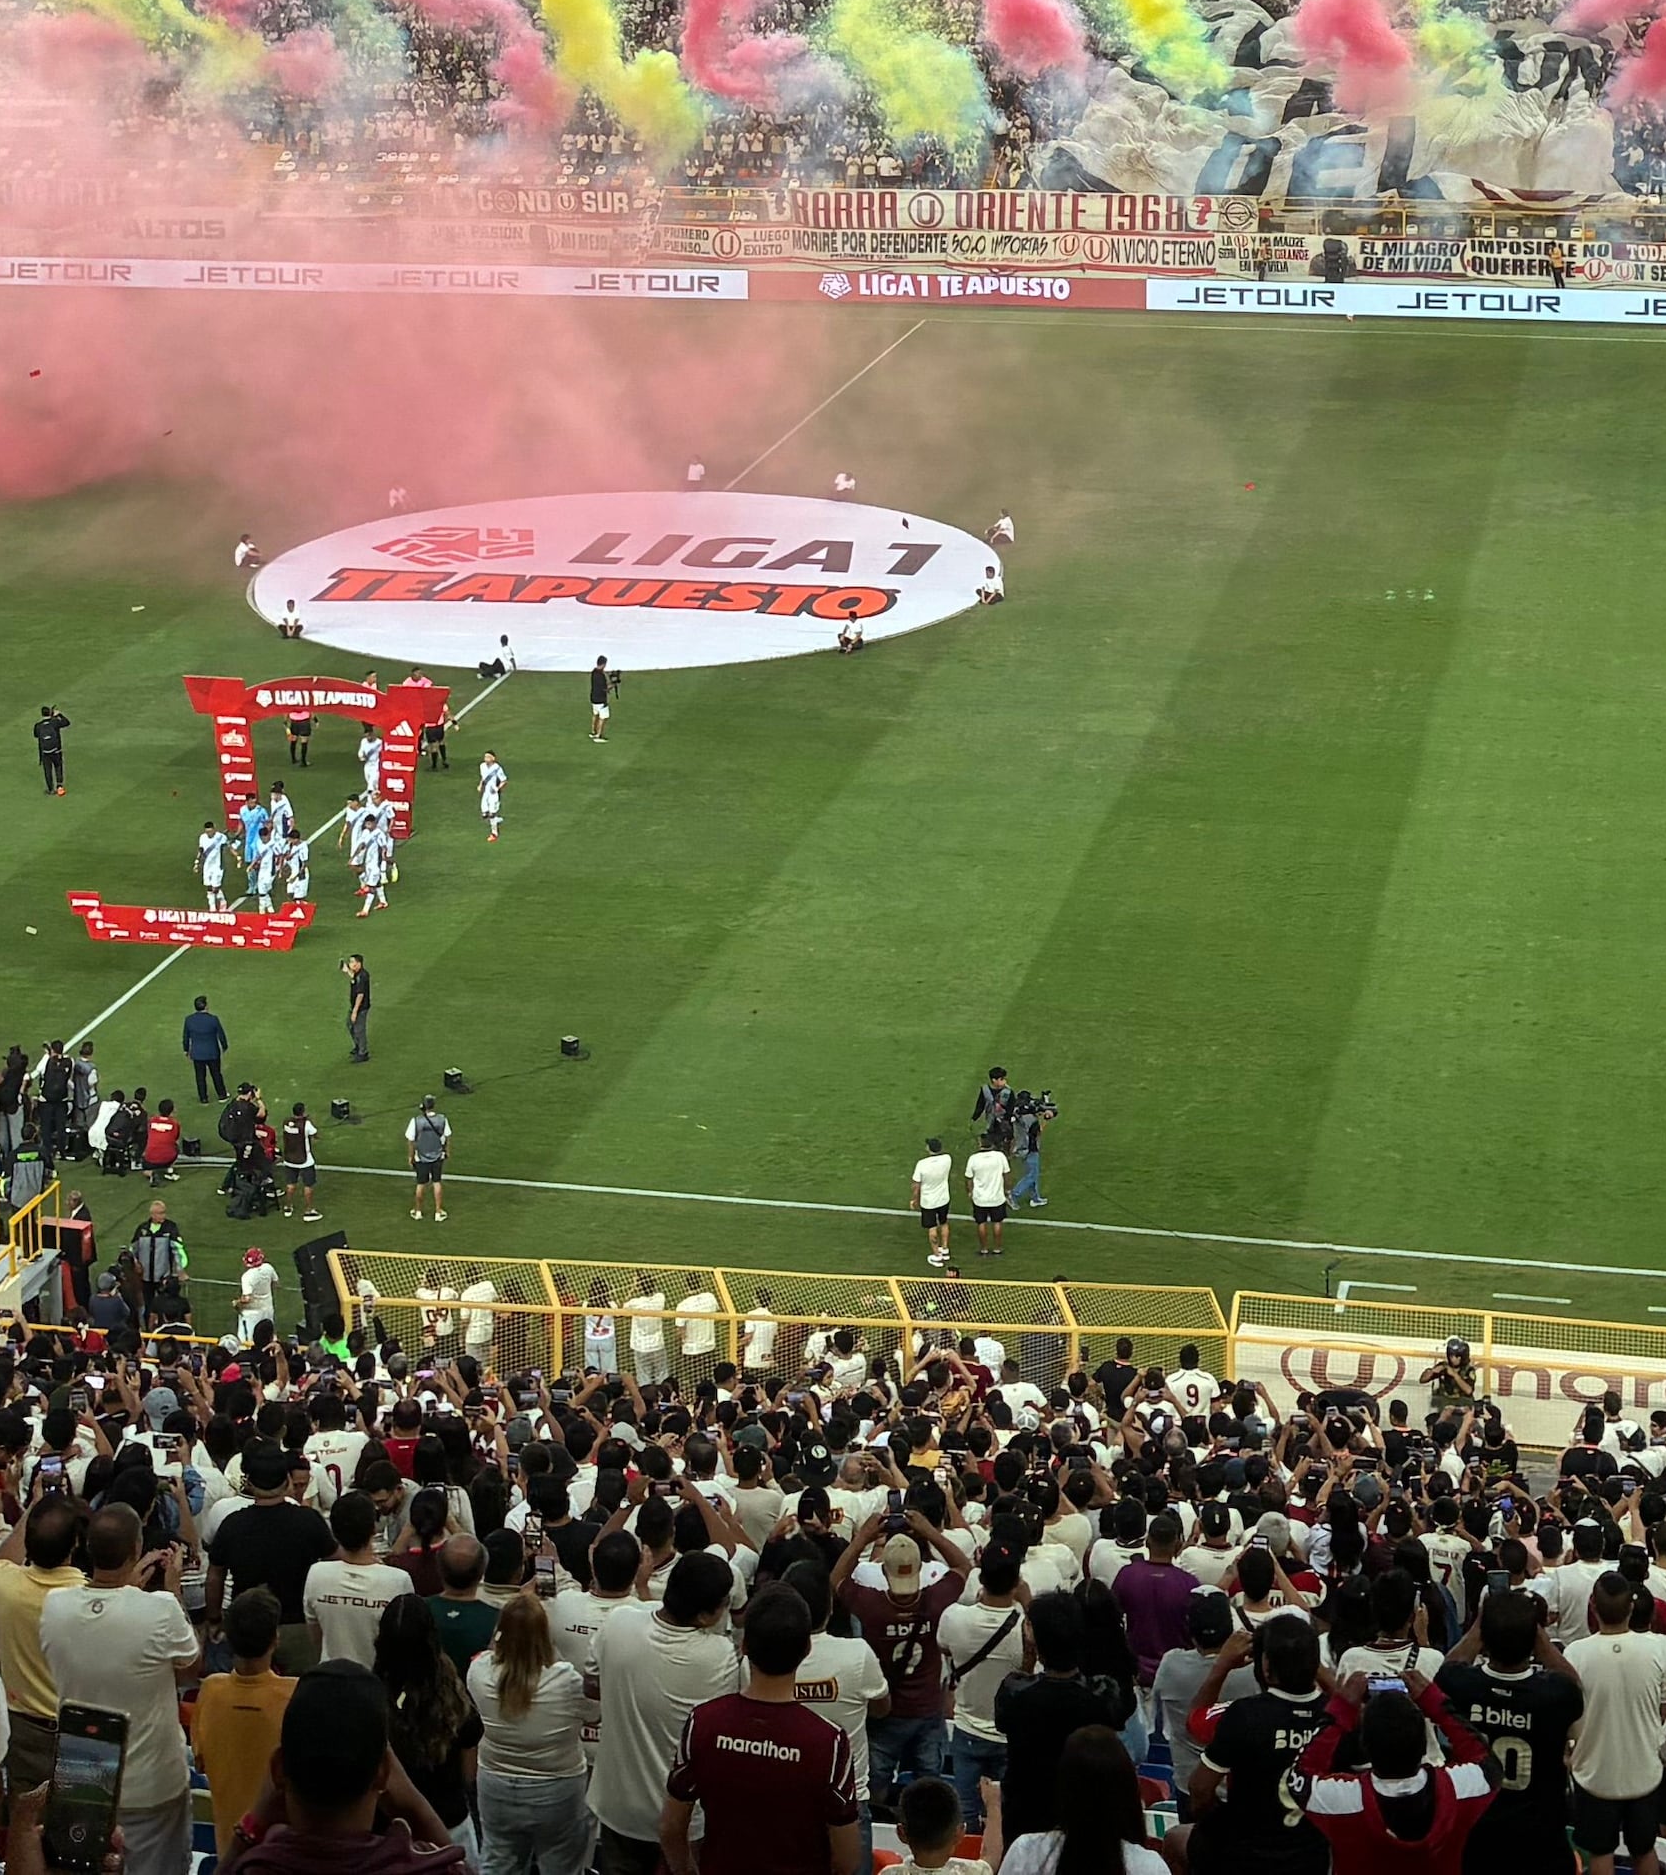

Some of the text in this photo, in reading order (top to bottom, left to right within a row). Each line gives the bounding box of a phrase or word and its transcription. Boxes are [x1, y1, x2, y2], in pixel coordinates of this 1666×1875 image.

[582, 191, 629, 213] SUR
[955, 191, 1088, 231] ORIENTE
[1103, 194, 1186, 231] 1968
[664, 228, 709, 241] PRIMERO
[842, 232, 948, 254] POR DEFENDERTE
[952, 234, 1048, 255] SOLO IMPORTAS
[743, 244, 783, 256] EXISTO
[1122, 237, 1216, 266] VICIO ETERNO
[1359, 240, 1460, 258] EL MILAGRO
[1582, 242, 1610, 258] NO
[183, 265, 324, 286] JETOUR
[1363, 256, 1453, 273] DE MI VIDA
[1471, 256, 1576, 278] QUERERE
[377, 269, 519, 289] JETOUR
[574, 273, 720, 294] JETOUR
[858, 273, 916, 296] LIGA
[1177, 286, 1335, 308] JETOUR
[1396, 292, 1562, 314] JETOUR
[568, 532, 944, 576] LIGA 1
[274, 690, 304, 706] LIGA
[1186, 1383, 1199, 1407] 9
[795, 1683, 832, 1700] ISTAL
[1485, 1706, 1532, 1731] bitel
[716, 1735, 801, 1763] marathon
